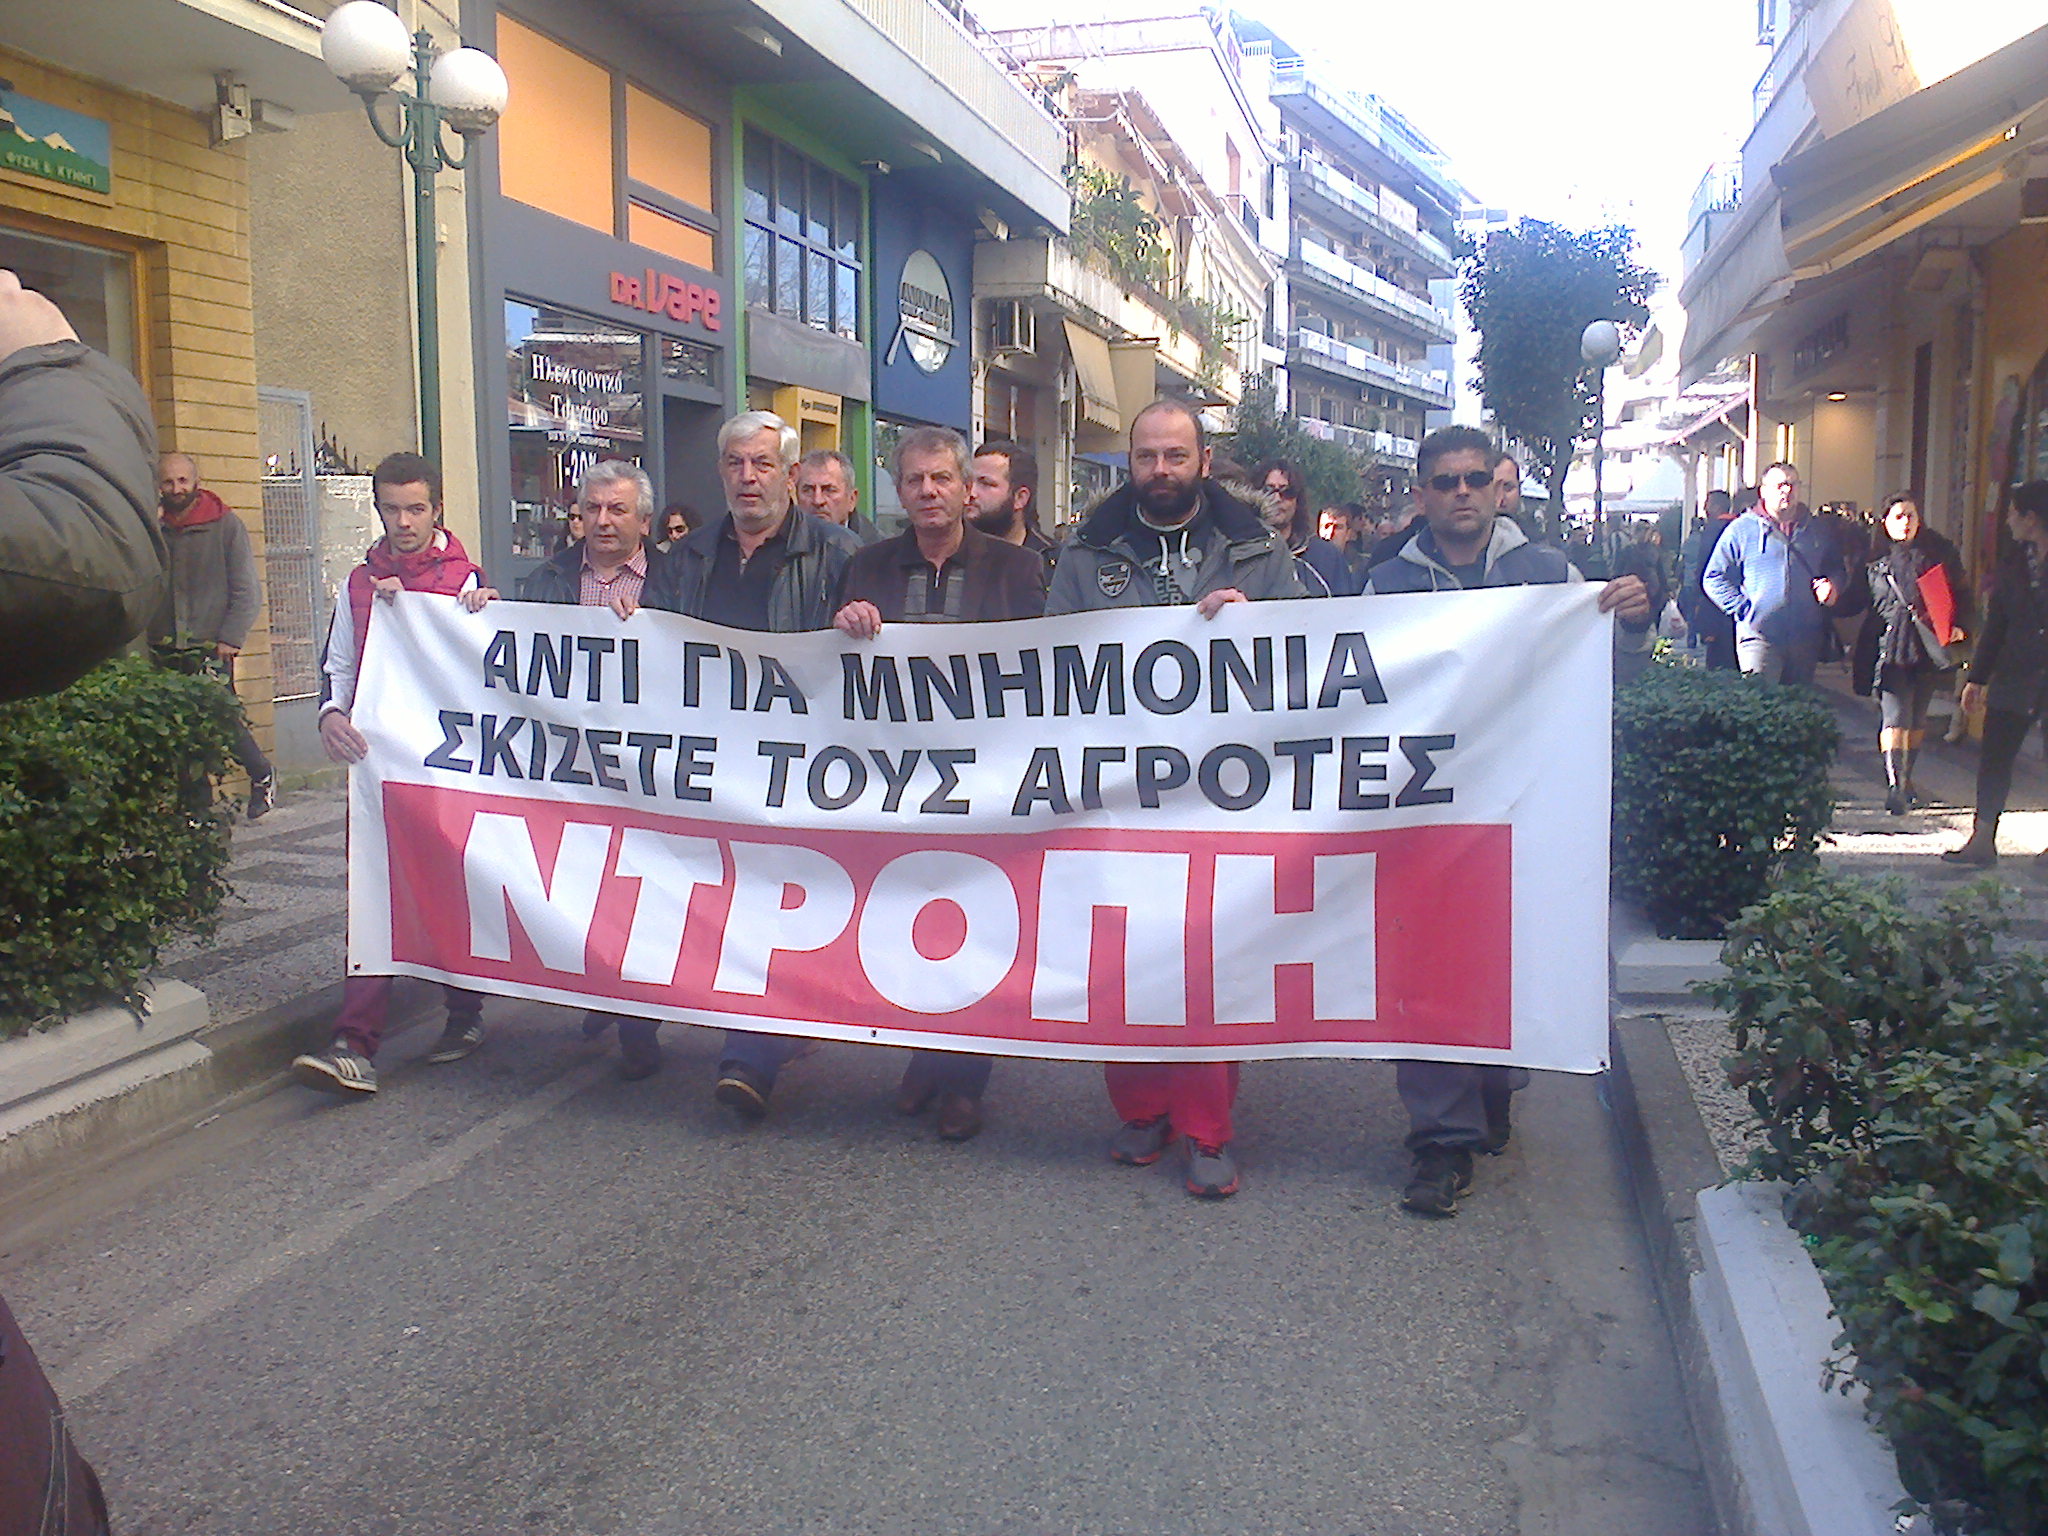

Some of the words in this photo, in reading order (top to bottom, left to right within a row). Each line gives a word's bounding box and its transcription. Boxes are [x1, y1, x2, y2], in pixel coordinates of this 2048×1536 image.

[484, 629, 640, 704] ΑΝΤΙ
[683, 641, 809, 714] ΓΙΑ
[841, 631, 1388, 722] ΜΝΗΜΟΝΙΑ
[424, 709, 718, 803] ΣΚΙΖΕΤΕ
[757, 740, 976, 815] ΤΟΥΣ
[1011, 734, 1456, 816] ΑΓΡΟΤΕΣ
[463, 810, 1378, 1027] ΝΤΡΟΠΗ
